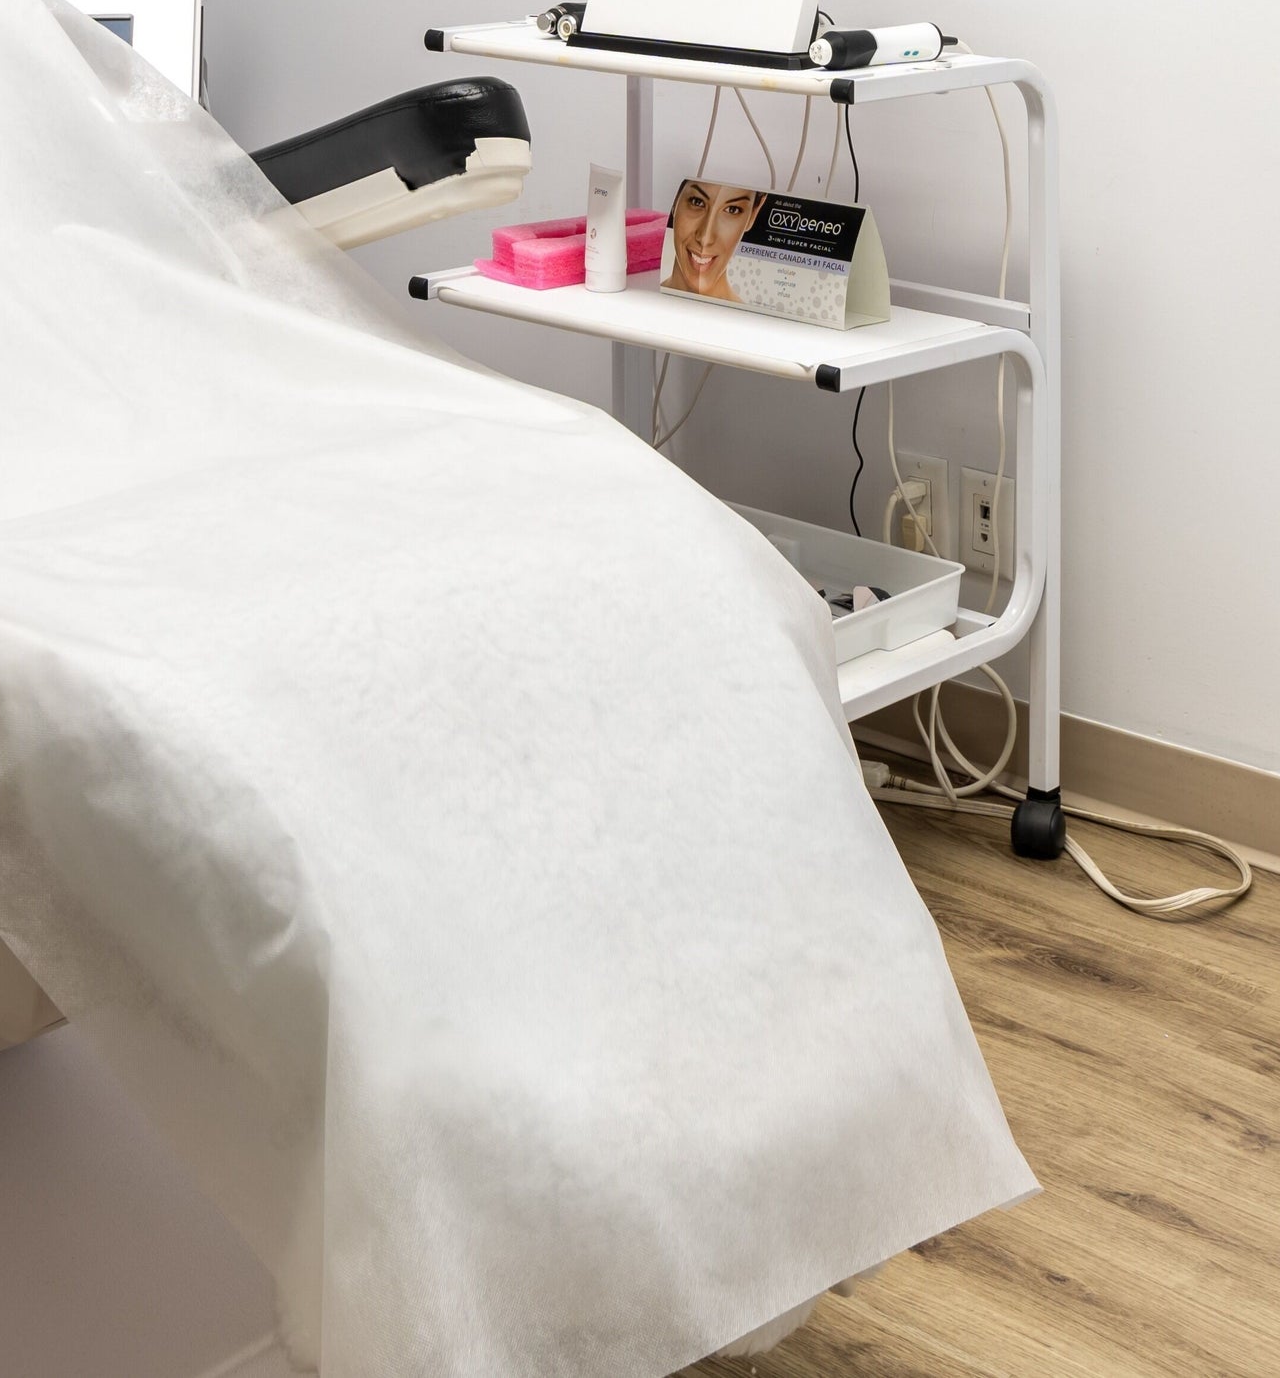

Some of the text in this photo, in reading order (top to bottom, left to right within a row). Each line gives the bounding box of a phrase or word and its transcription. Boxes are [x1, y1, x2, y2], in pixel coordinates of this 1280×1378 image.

[787, 239, 808, 247] SUPER
[809, 243, 831, 253] FACIAL
[740, 245, 777, 261] EXPERIENCE
[779, 252, 812, 266] CANADA'S
[822, 261, 845, 272] FACIAL
